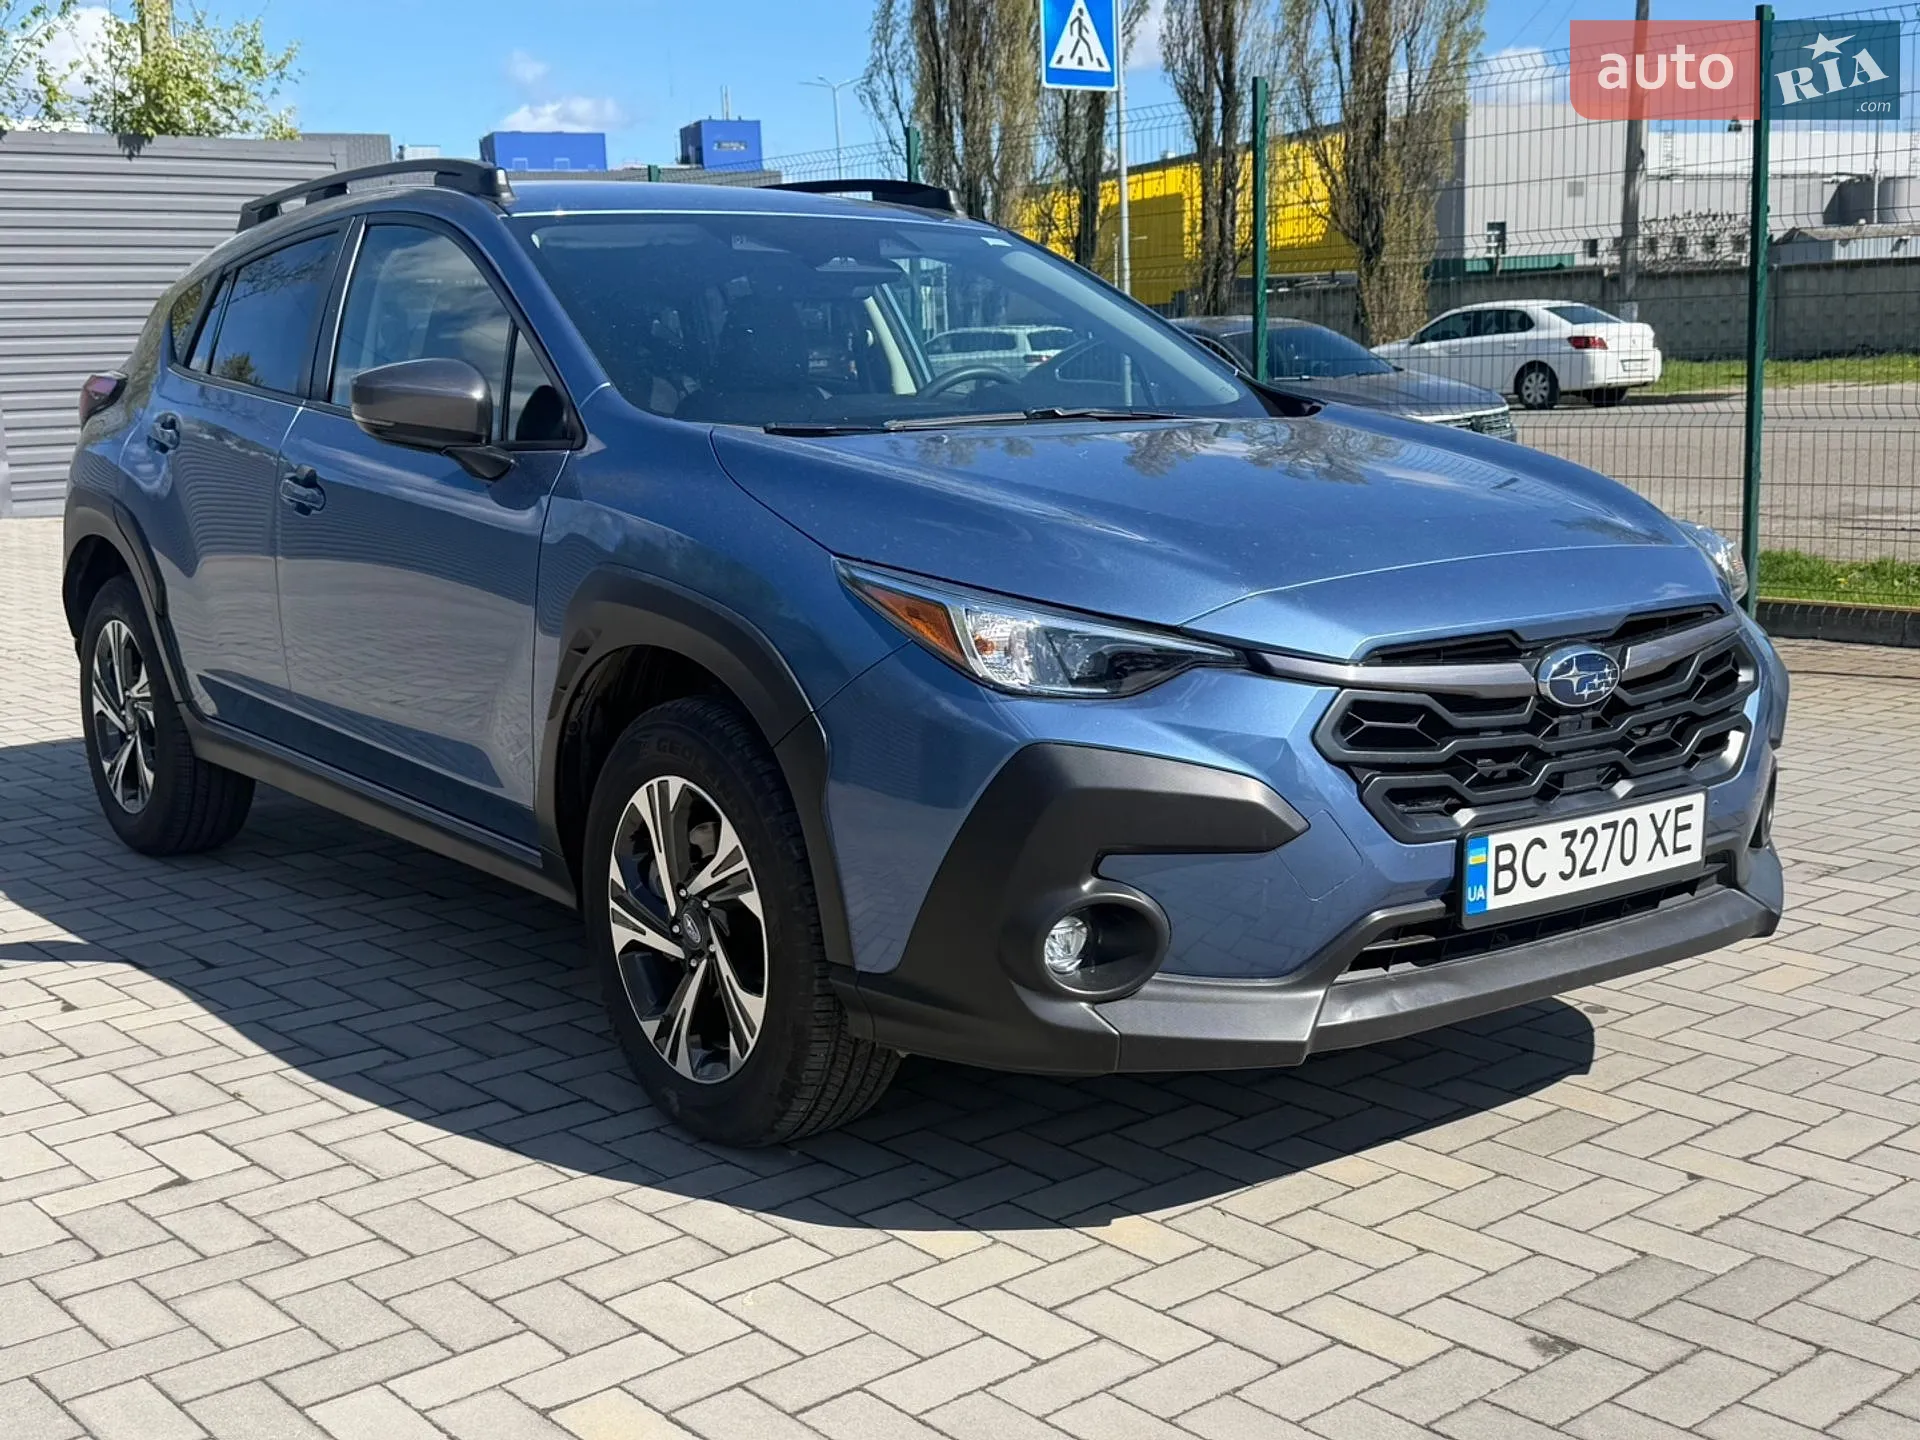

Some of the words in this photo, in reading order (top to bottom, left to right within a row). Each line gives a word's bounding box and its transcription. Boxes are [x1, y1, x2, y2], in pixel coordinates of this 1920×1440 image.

[1493, 837, 1548, 897] BC
[1558, 817, 1638, 881] 3270
[1647, 803, 1694, 862] XE
[1467, 884, 1486, 902] UA
